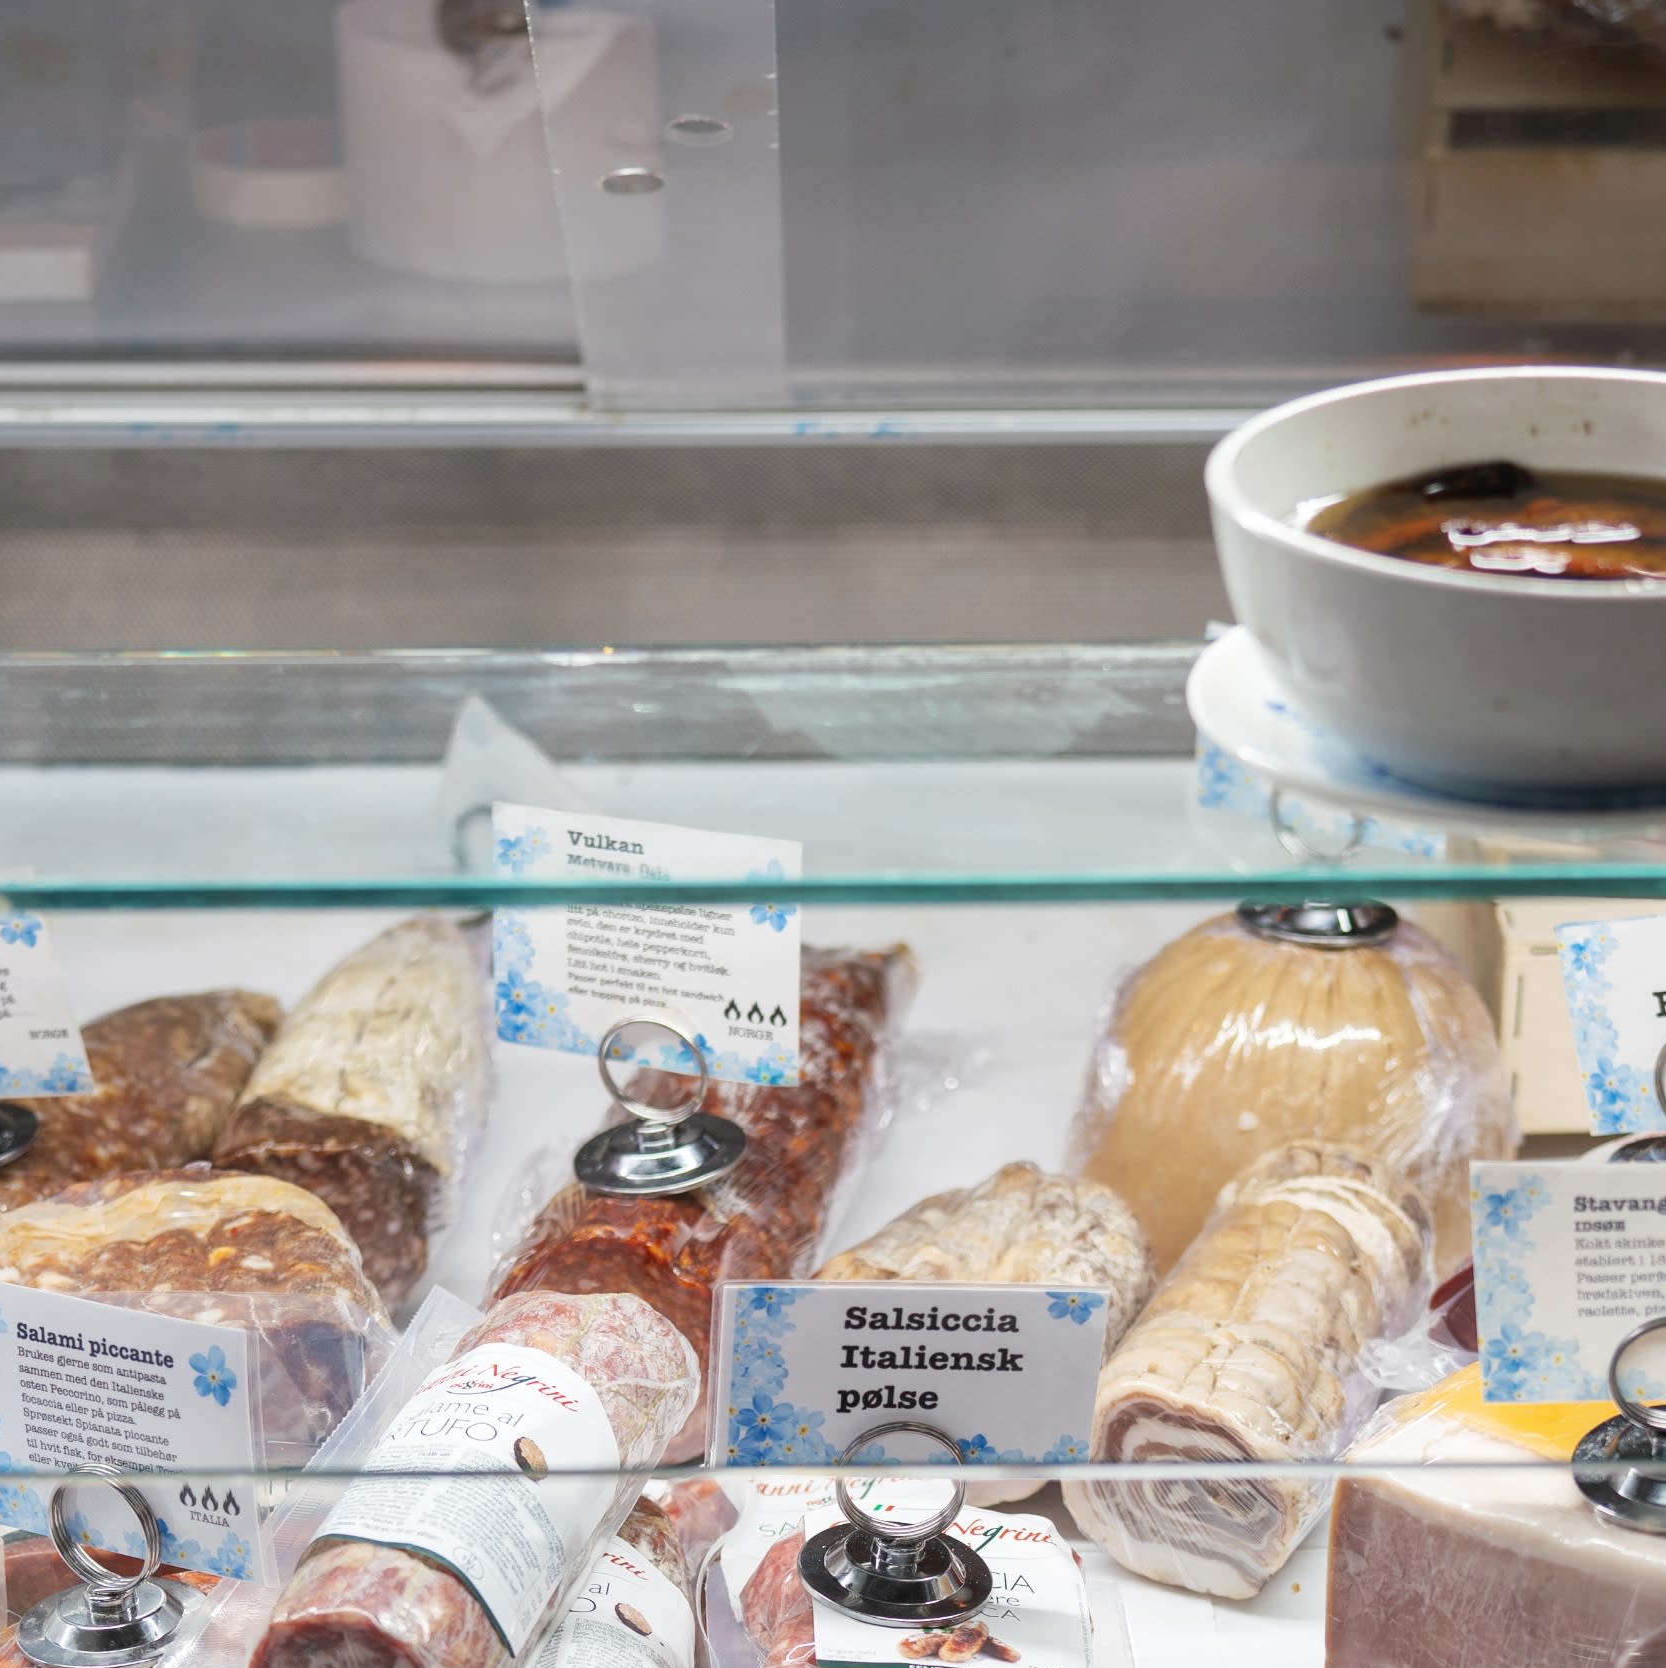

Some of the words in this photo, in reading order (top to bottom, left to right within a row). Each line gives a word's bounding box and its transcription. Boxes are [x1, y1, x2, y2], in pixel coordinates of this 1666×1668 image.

[567, 830, 645, 855] Vulkan
[728, 1026, 774, 1041] NORGE
[1574, 1237, 1612, 1250] Kokt
[1614, 1236, 1665, 1249] skinke
[1576, 1272, 1626, 1283] Passer
[1576, 1287, 1664, 1300] brødskiven,
[843, 1305, 1020, 1335] Salsiccia
[16, 1322, 84, 1351] Salami
[89, 1339, 174, 1369] piccante
[840, 1344, 1024, 1372] Italiensk
[17, 1347, 54, 1364] Brukes
[57, 1357, 89, 1370] gjerne
[92, 1364, 113, 1375] som
[116, 1368, 166, 1385] antipasta
[19, 1365, 62, 1380] sammen
[65, 1374, 87, 1385] med
[90, 1376, 109, 1390] den
[111, 1380, 165, 1401] Italienske
[478, 1364, 579, 1412] Negrini
[19, 1380, 47, 1393] osten
[50, 1384, 104, 1405] Peccorino,
[107, 1397, 128, 1408] som
[131, 1400, 165, 1419] pålegg
[168, 1407, 181, 1421] på
[21, 1392, 63, 1410] focaccia
[66, 1402, 89, 1415] eller
[91, 1407, 105, 1420] på
[107, 1410, 136, 1424] pizza.
[836, 1384, 939, 1414] pølse
[23, 1407, 73, 1427] Sprøstekt
[75, 1417, 122, 1436] Spianata
[124, 1428, 169, 1446] piccante
[497, 1412, 524, 1427] al
[25, 1425, 58, 1438] passer
[60, 1432, 84, 1445] også
[86, 1436, 109, 1449] godt
[111, 1442, 133, 1453] som
[135, 1444, 177, 1462] tilbehør
[26, 1437, 37, 1449] til
[40, 1439, 61, 1453] hvit
[63, 1444, 85, 1460] fisk,
[88, 1449, 103, 1462] for
[104, 1454, 154, 1473] eksempel
[28, 1451, 51, 1464] eller
[189, 1511, 230, 1528] ITALIA
